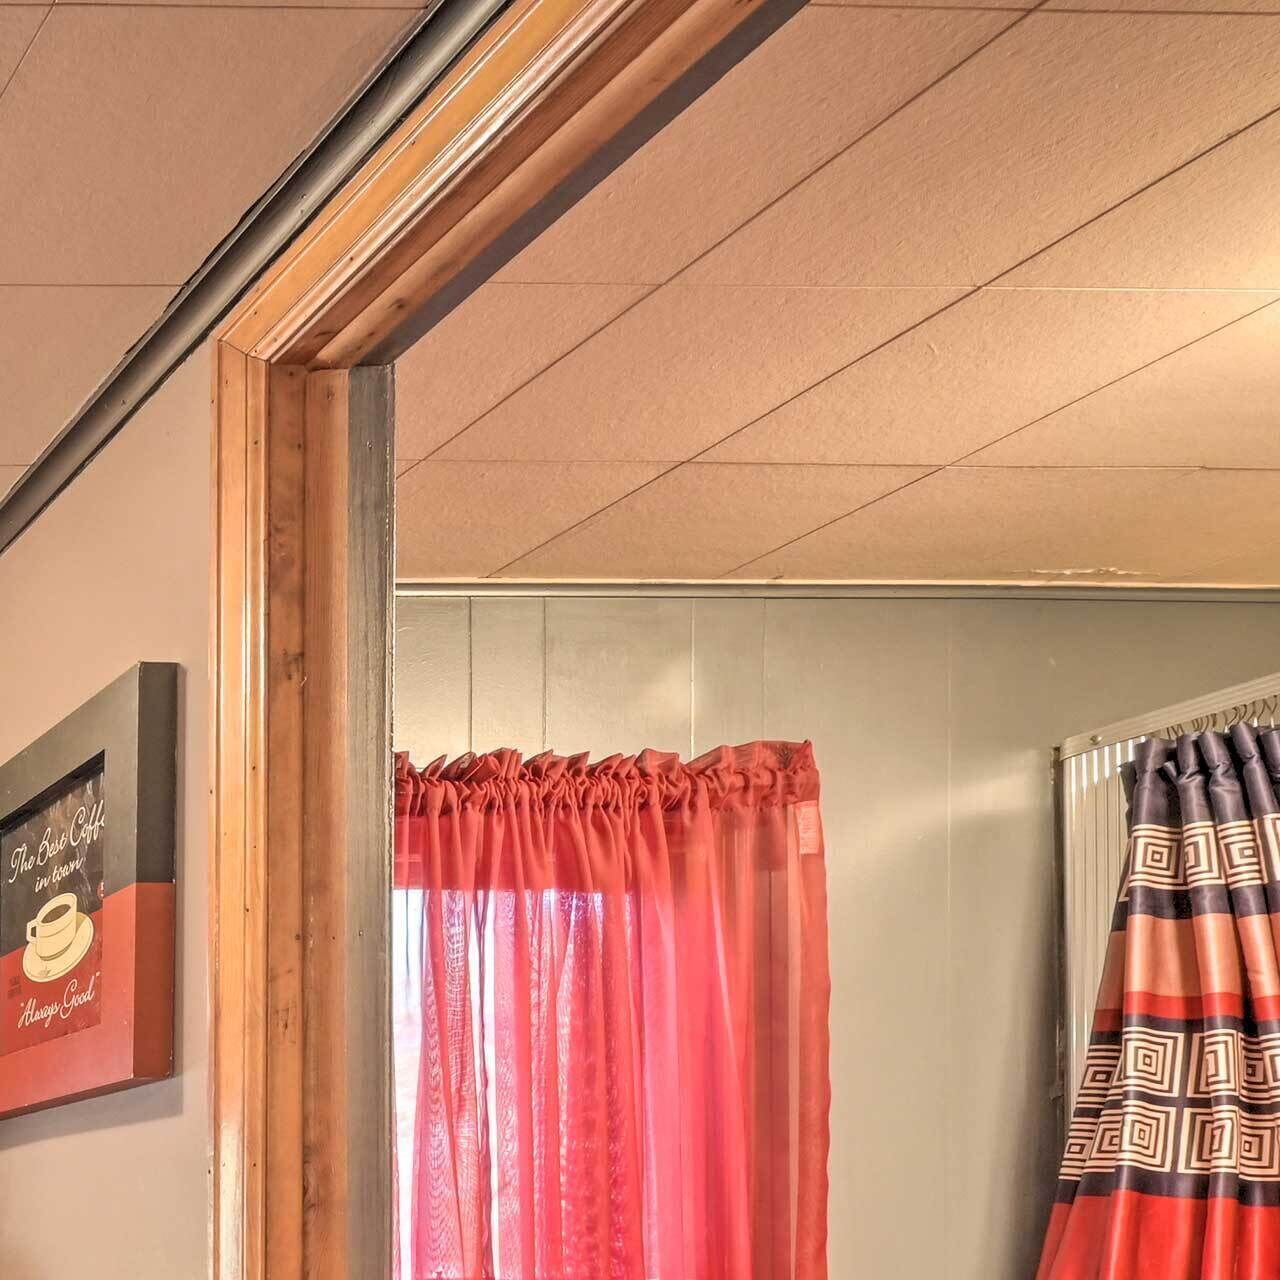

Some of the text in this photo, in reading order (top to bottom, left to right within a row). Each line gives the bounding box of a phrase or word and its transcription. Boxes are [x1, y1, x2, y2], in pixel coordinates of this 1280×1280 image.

[9, 843, 36, 884] The
[37, 827, 69, 866] Best
[35, 857, 84, 893] in town
